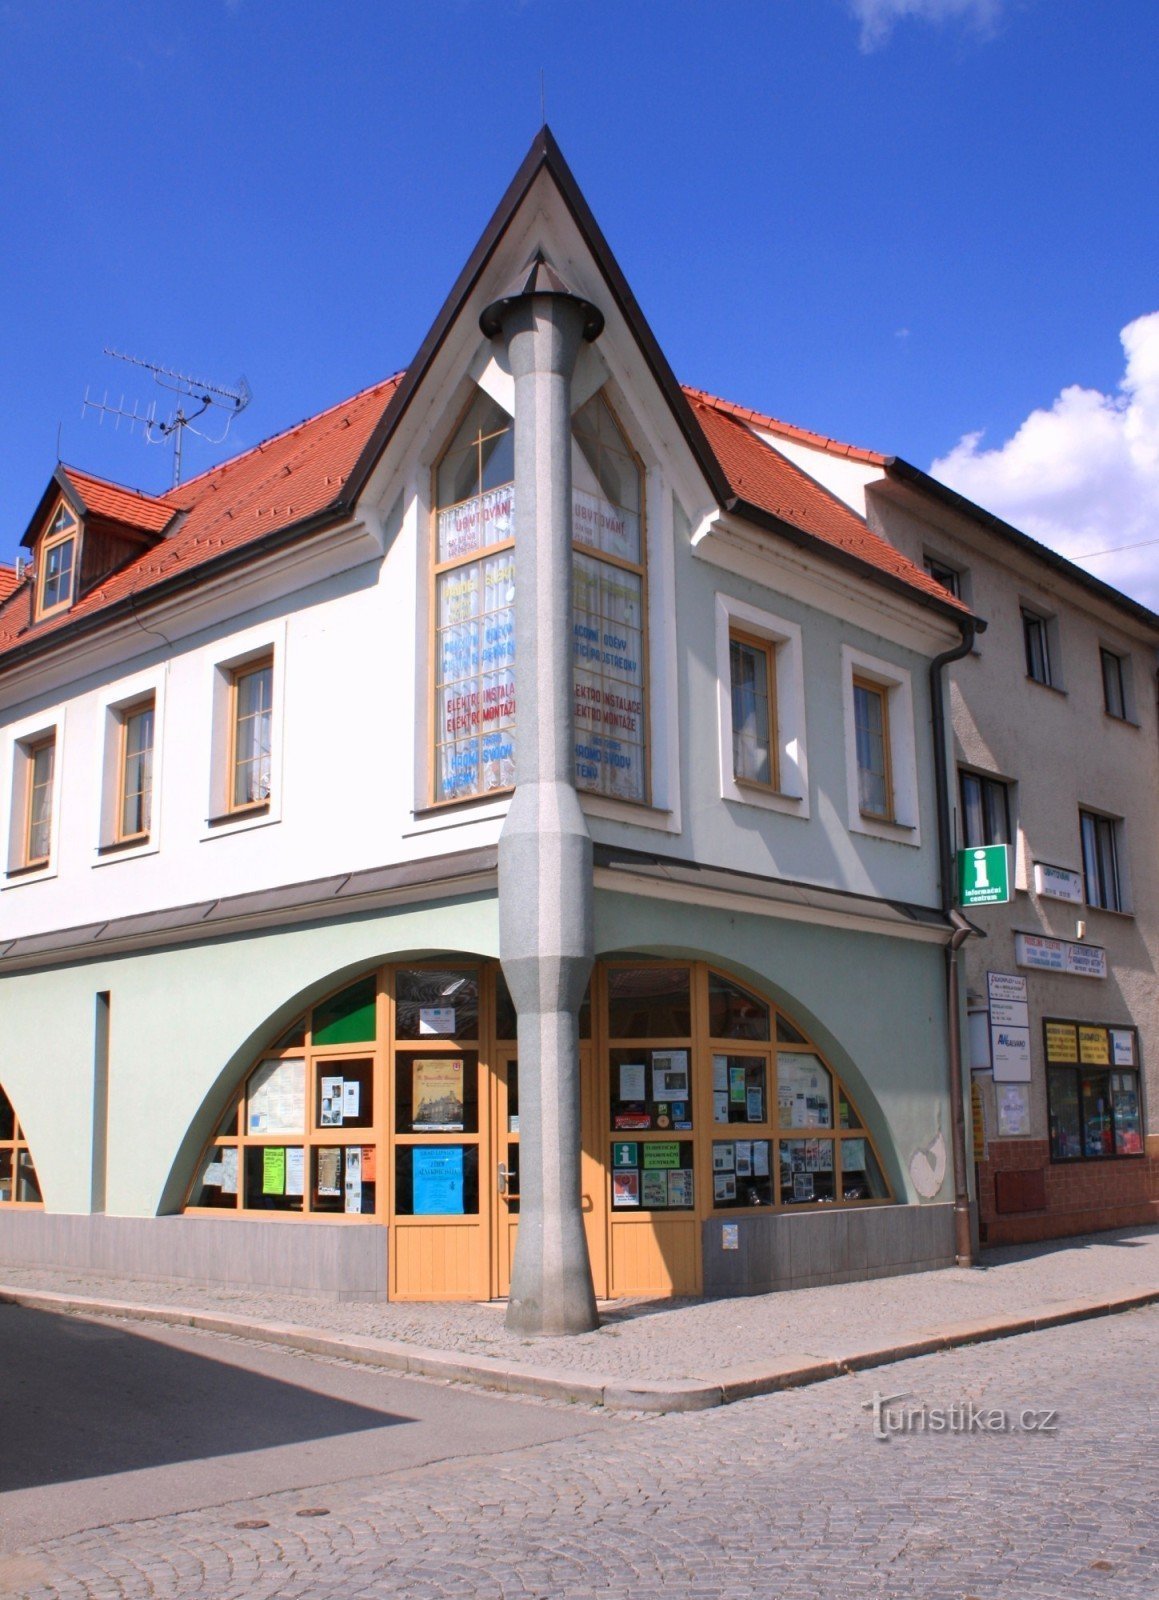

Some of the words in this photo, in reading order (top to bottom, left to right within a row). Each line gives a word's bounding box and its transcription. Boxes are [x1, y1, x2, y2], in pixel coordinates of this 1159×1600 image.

[573, 683, 601, 703] EKTRO
[573, 703, 601, 722] EKTRO
[965, 886, 1002, 897] informační
[970, 894, 998, 902] centrum
